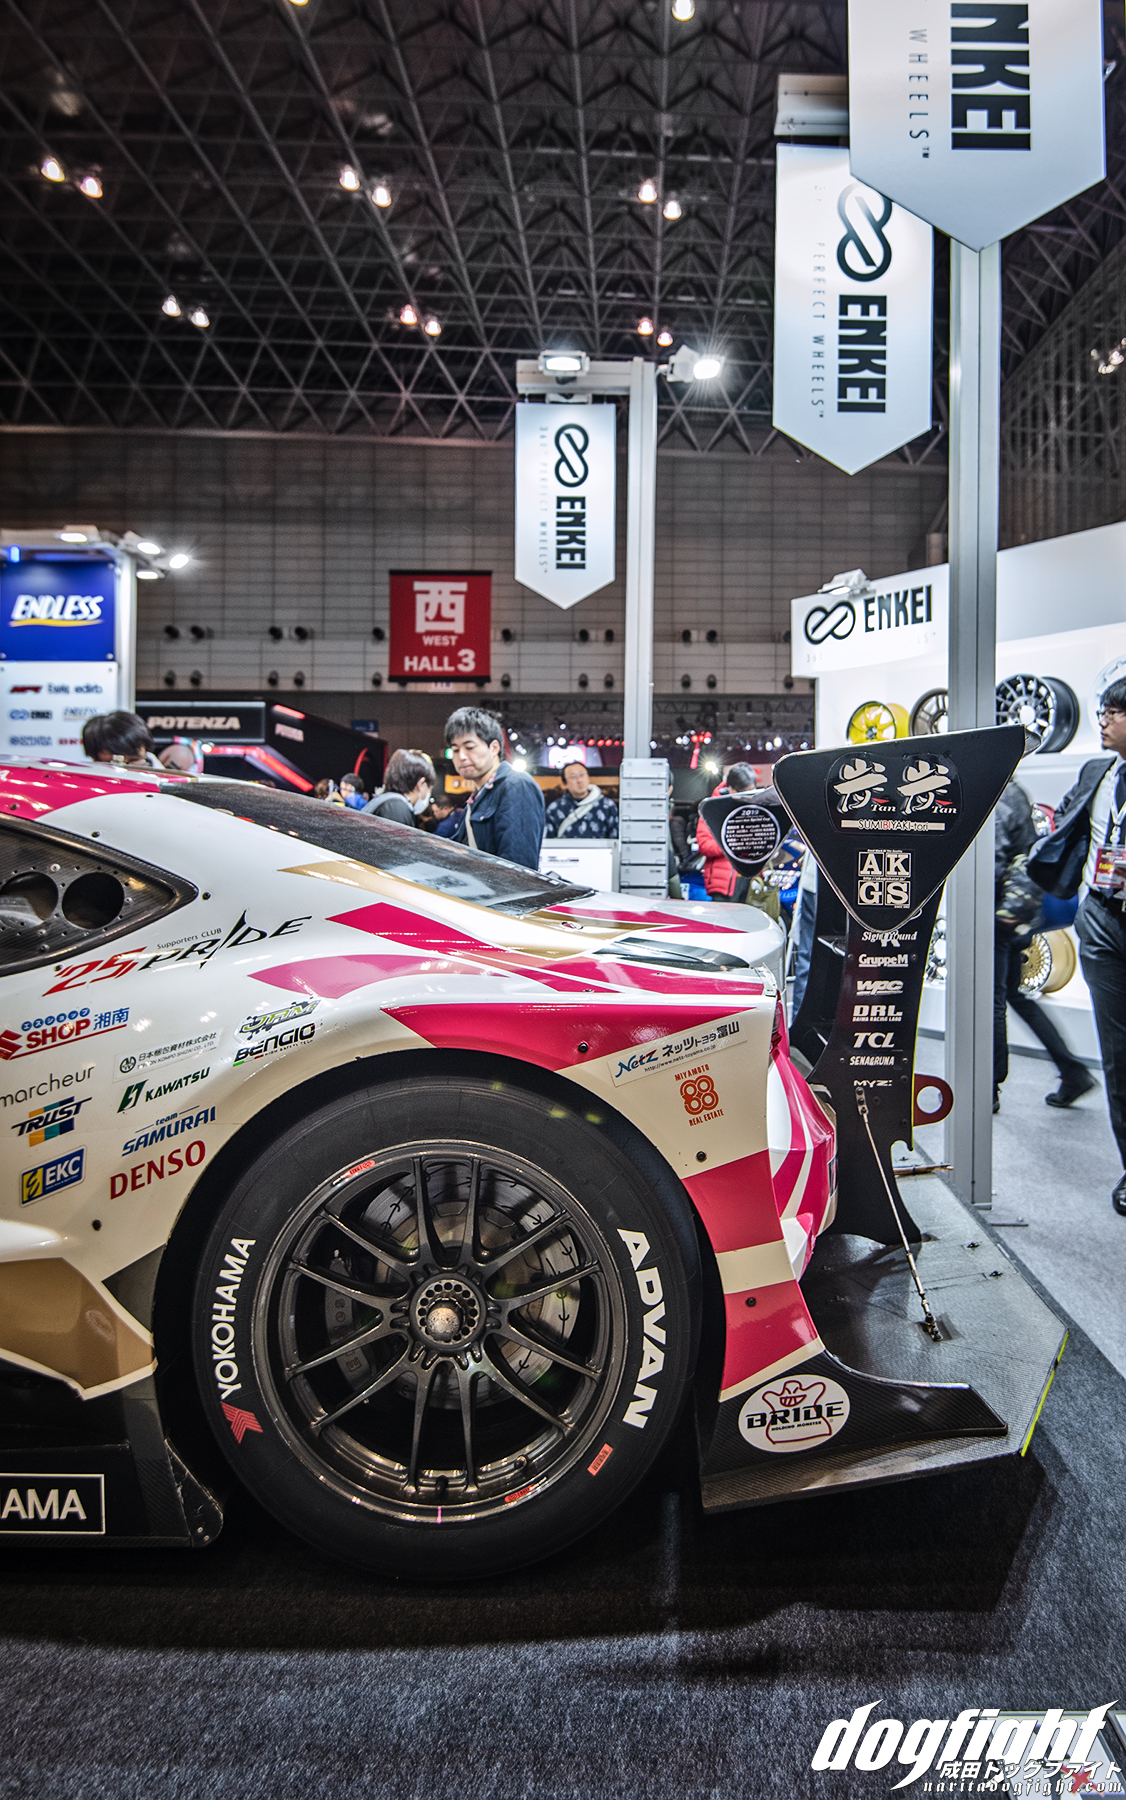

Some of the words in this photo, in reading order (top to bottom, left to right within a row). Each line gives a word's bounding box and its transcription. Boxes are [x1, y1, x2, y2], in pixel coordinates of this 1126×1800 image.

[950, 3, 1031, 152] NKEI
[837, 294, 887, 414] ENKEI
[556, 495, 586, 570] ENKEI
[10, 595, 104, 621] ENDLESS
[413, 581, 468, 634] 西
[864, 584, 933, 633] ENKEI
[422, 635, 458, 646] WEST
[404, 656, 455, 672] HALL
[457, 649, 476, 672] 3
[147, 716, 241, 730] POTENZA
[870, 803, 897, 812] Tan
[931, 805, 957, 814] Tan
[156, 935, 199, 950] Supporters
[201, 927, 222, 938] CLUB
[858, 953, 909, 967] GruppeM
[852, 1005, 903, 1016] DRL
[26, 1018, 91, 1049] SHOP
[93, 1006, 131, 1031] 湘南
[662, 1021, 740, 1058] ネッツトヨタ富山
[853, 1032, 895, 1048] TCL
[0, 1066, 95, 1108] marcheur
[145, 1067, 211, 1102] KAWATSU
[674, 1063, 710, 1081] MIYAMOTO
[12, 1097, 93, 1137] TRUST
[122, 1106, 216, 1157] SAMURAI
[155, 1112, 178, 1126] team
[688, 1116, 704, 1127] REAL
[703, 1108, 725, 1122] ESTATE
[45, 1156, 81, 1186] EKC
[110, 1140, 206, 1200] DENSO
[211, 1237, 256, 1400] YOKOHAMA
[617, 1228, 666, 1429] ADVAN
[745, 1401, 844, 1429] BRIDE
[1, 1488, 87, 1520] AMA
